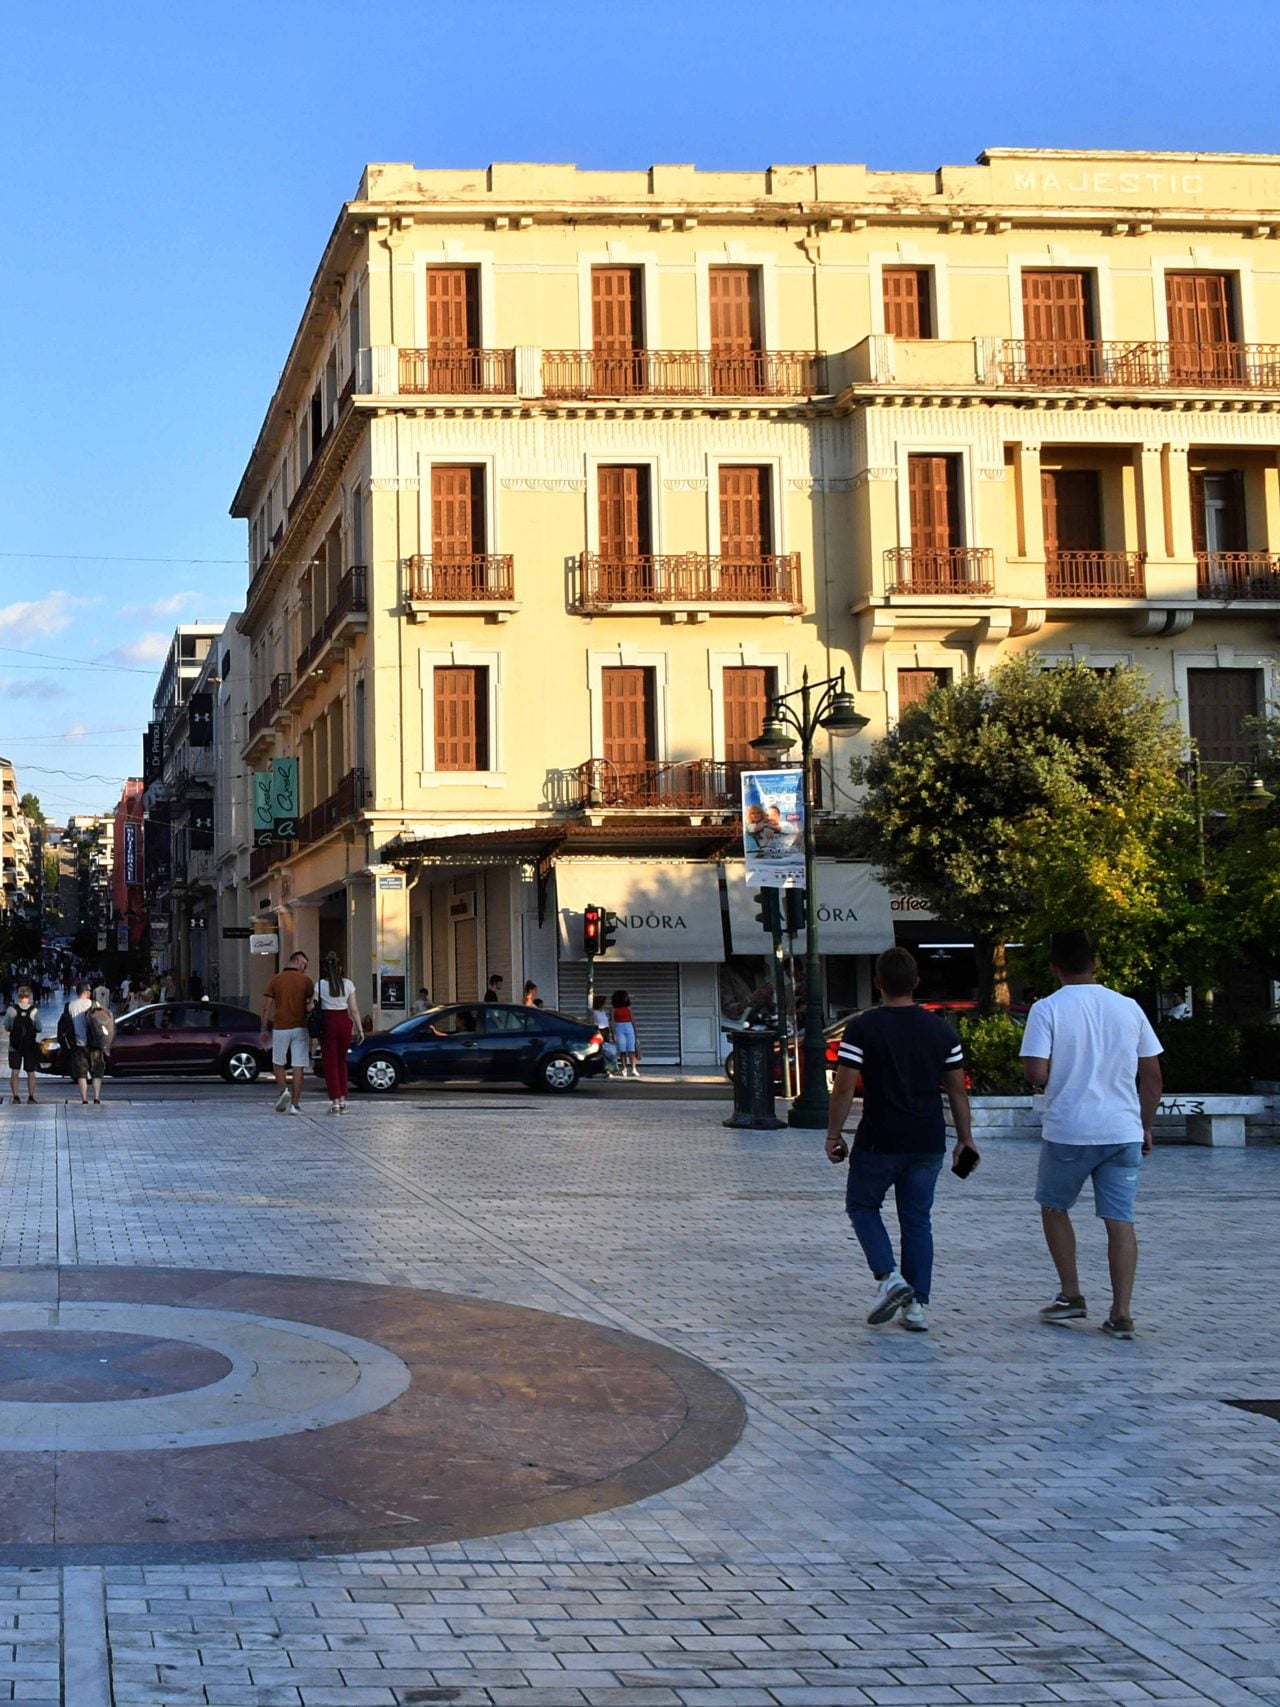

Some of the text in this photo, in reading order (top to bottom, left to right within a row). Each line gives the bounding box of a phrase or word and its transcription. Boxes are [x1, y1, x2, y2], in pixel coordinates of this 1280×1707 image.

[1013, 171, 1204, 194] MAJESTIC
[890, 895, 929, 911] offee
[603, 911, 687, 929] NDORA
